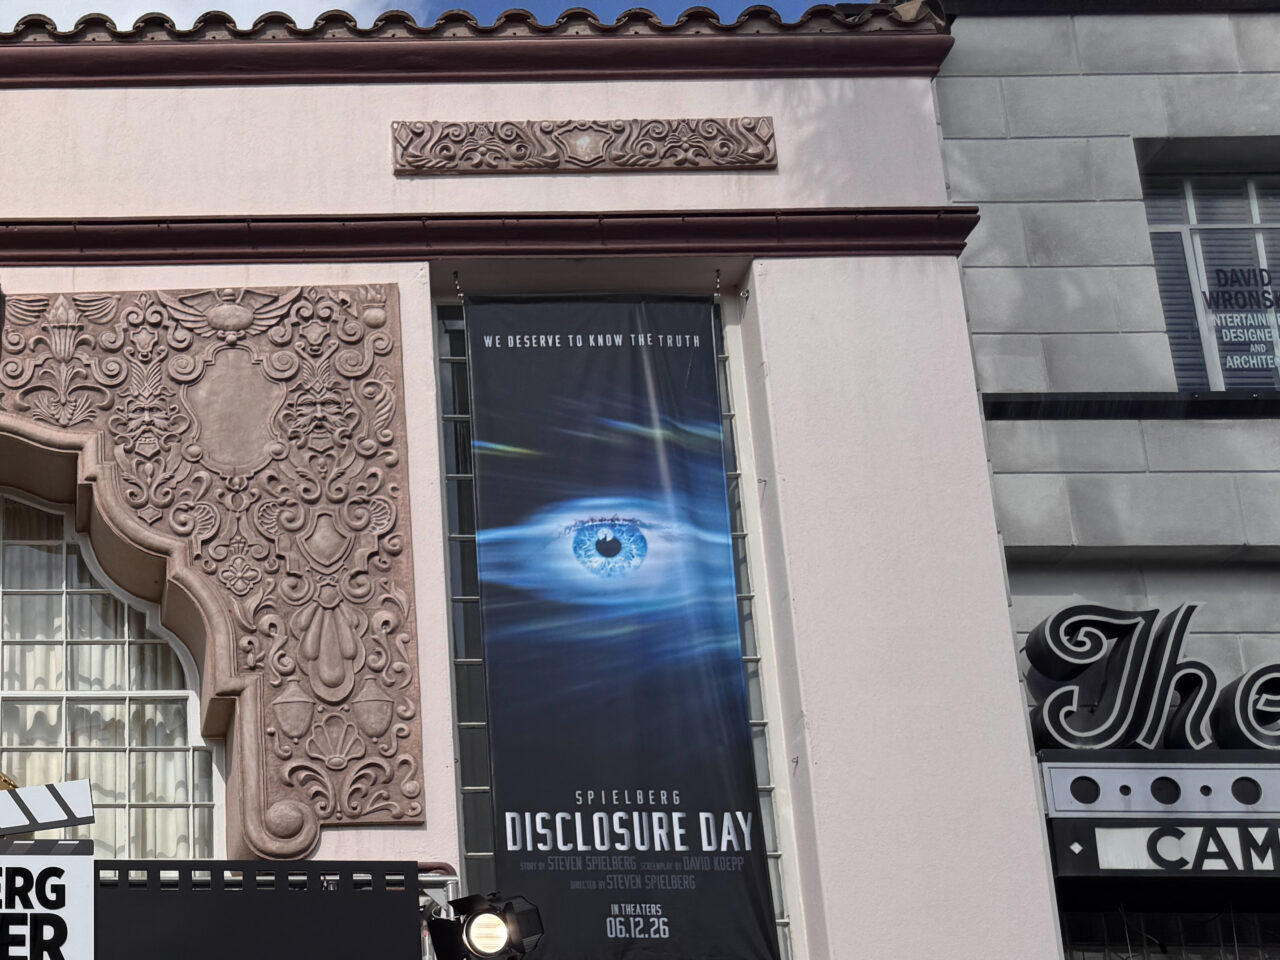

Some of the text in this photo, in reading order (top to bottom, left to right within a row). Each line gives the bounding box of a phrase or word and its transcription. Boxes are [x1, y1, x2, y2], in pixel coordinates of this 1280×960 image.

[1215, 268, 1272, 287] DAVID
[483, 333, 700, 348] WE DESERVE TO KNOW THE TRUTH
[1249, 344, 1266, 353] AND
[1038, 601, 1280, 750] The
[575, 790, 680, 806] SPIELBERG
[505, 811, 753, 852] DISCLOSURE DAY
[1146, 826, 1280, 871] CAM
[547, 856, 582, 870] STEVEN
[585, 856, 637, 870] SPIELBERG
[683, 856, 710, 871] DAVID
[713, 856, 744, 872] KOEPP
[606, 874, 642, 889] STEVEN
[644, 874, 696, 889] SPIELBERG
[610, 904, 662, 916] IN THEATERS
[606, 917, 669, 938] 06.12.26
